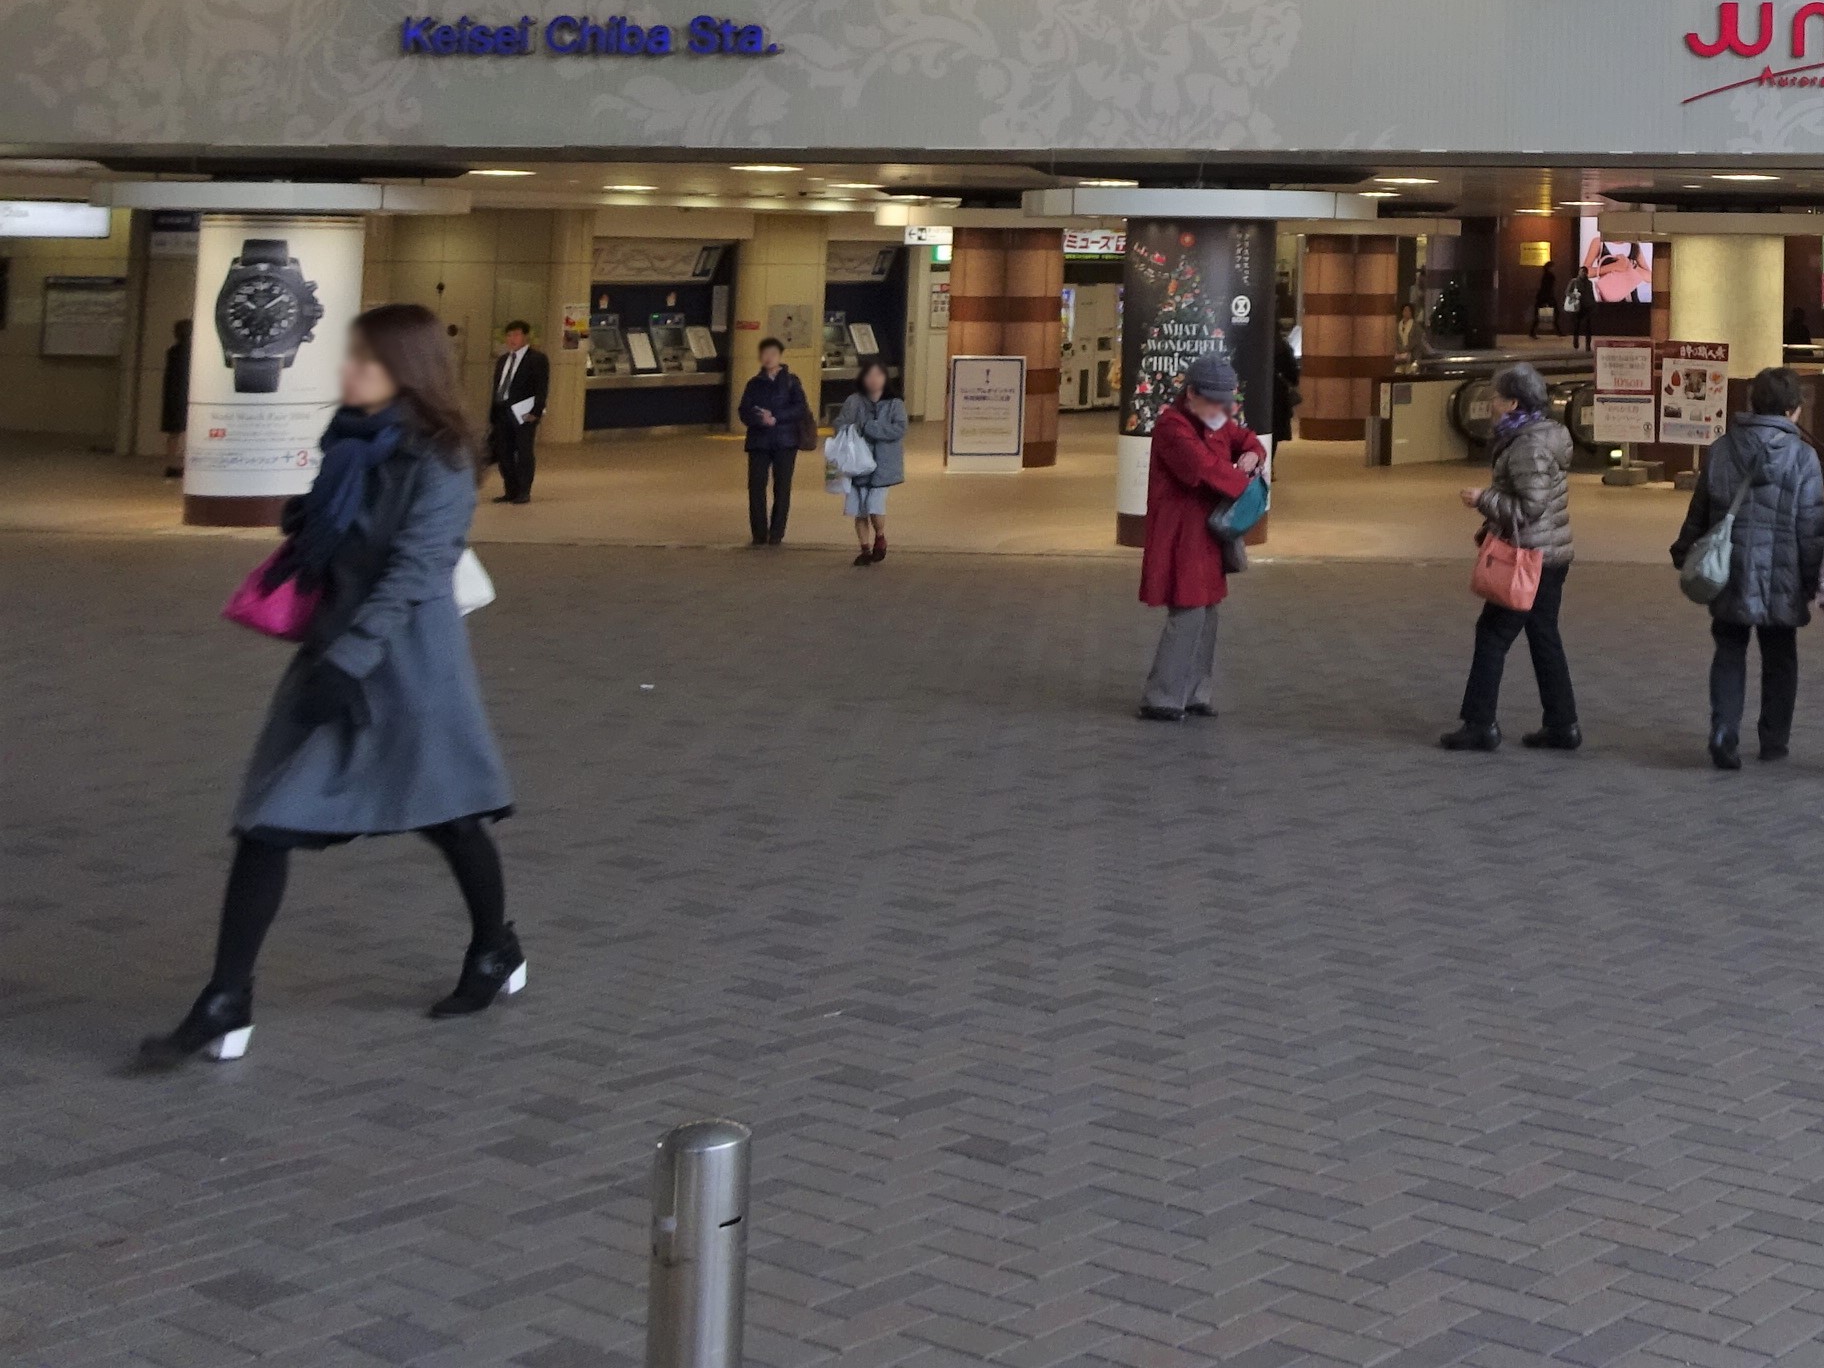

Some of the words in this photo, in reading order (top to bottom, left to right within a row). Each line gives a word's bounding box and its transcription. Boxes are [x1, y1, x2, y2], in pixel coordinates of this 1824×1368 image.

[400, 14, 536, 56] Keisei
[544, 14, 672, 56] Chiba
[687, 14, 782, 56] Sta.
[1064, 234, 1114, 250] ミューズ
[1162, 322, 1199, 336] WHAT
[1202, 323, 1209, 336] A
[1146, 338, 1228, 355] WONDERFUL
